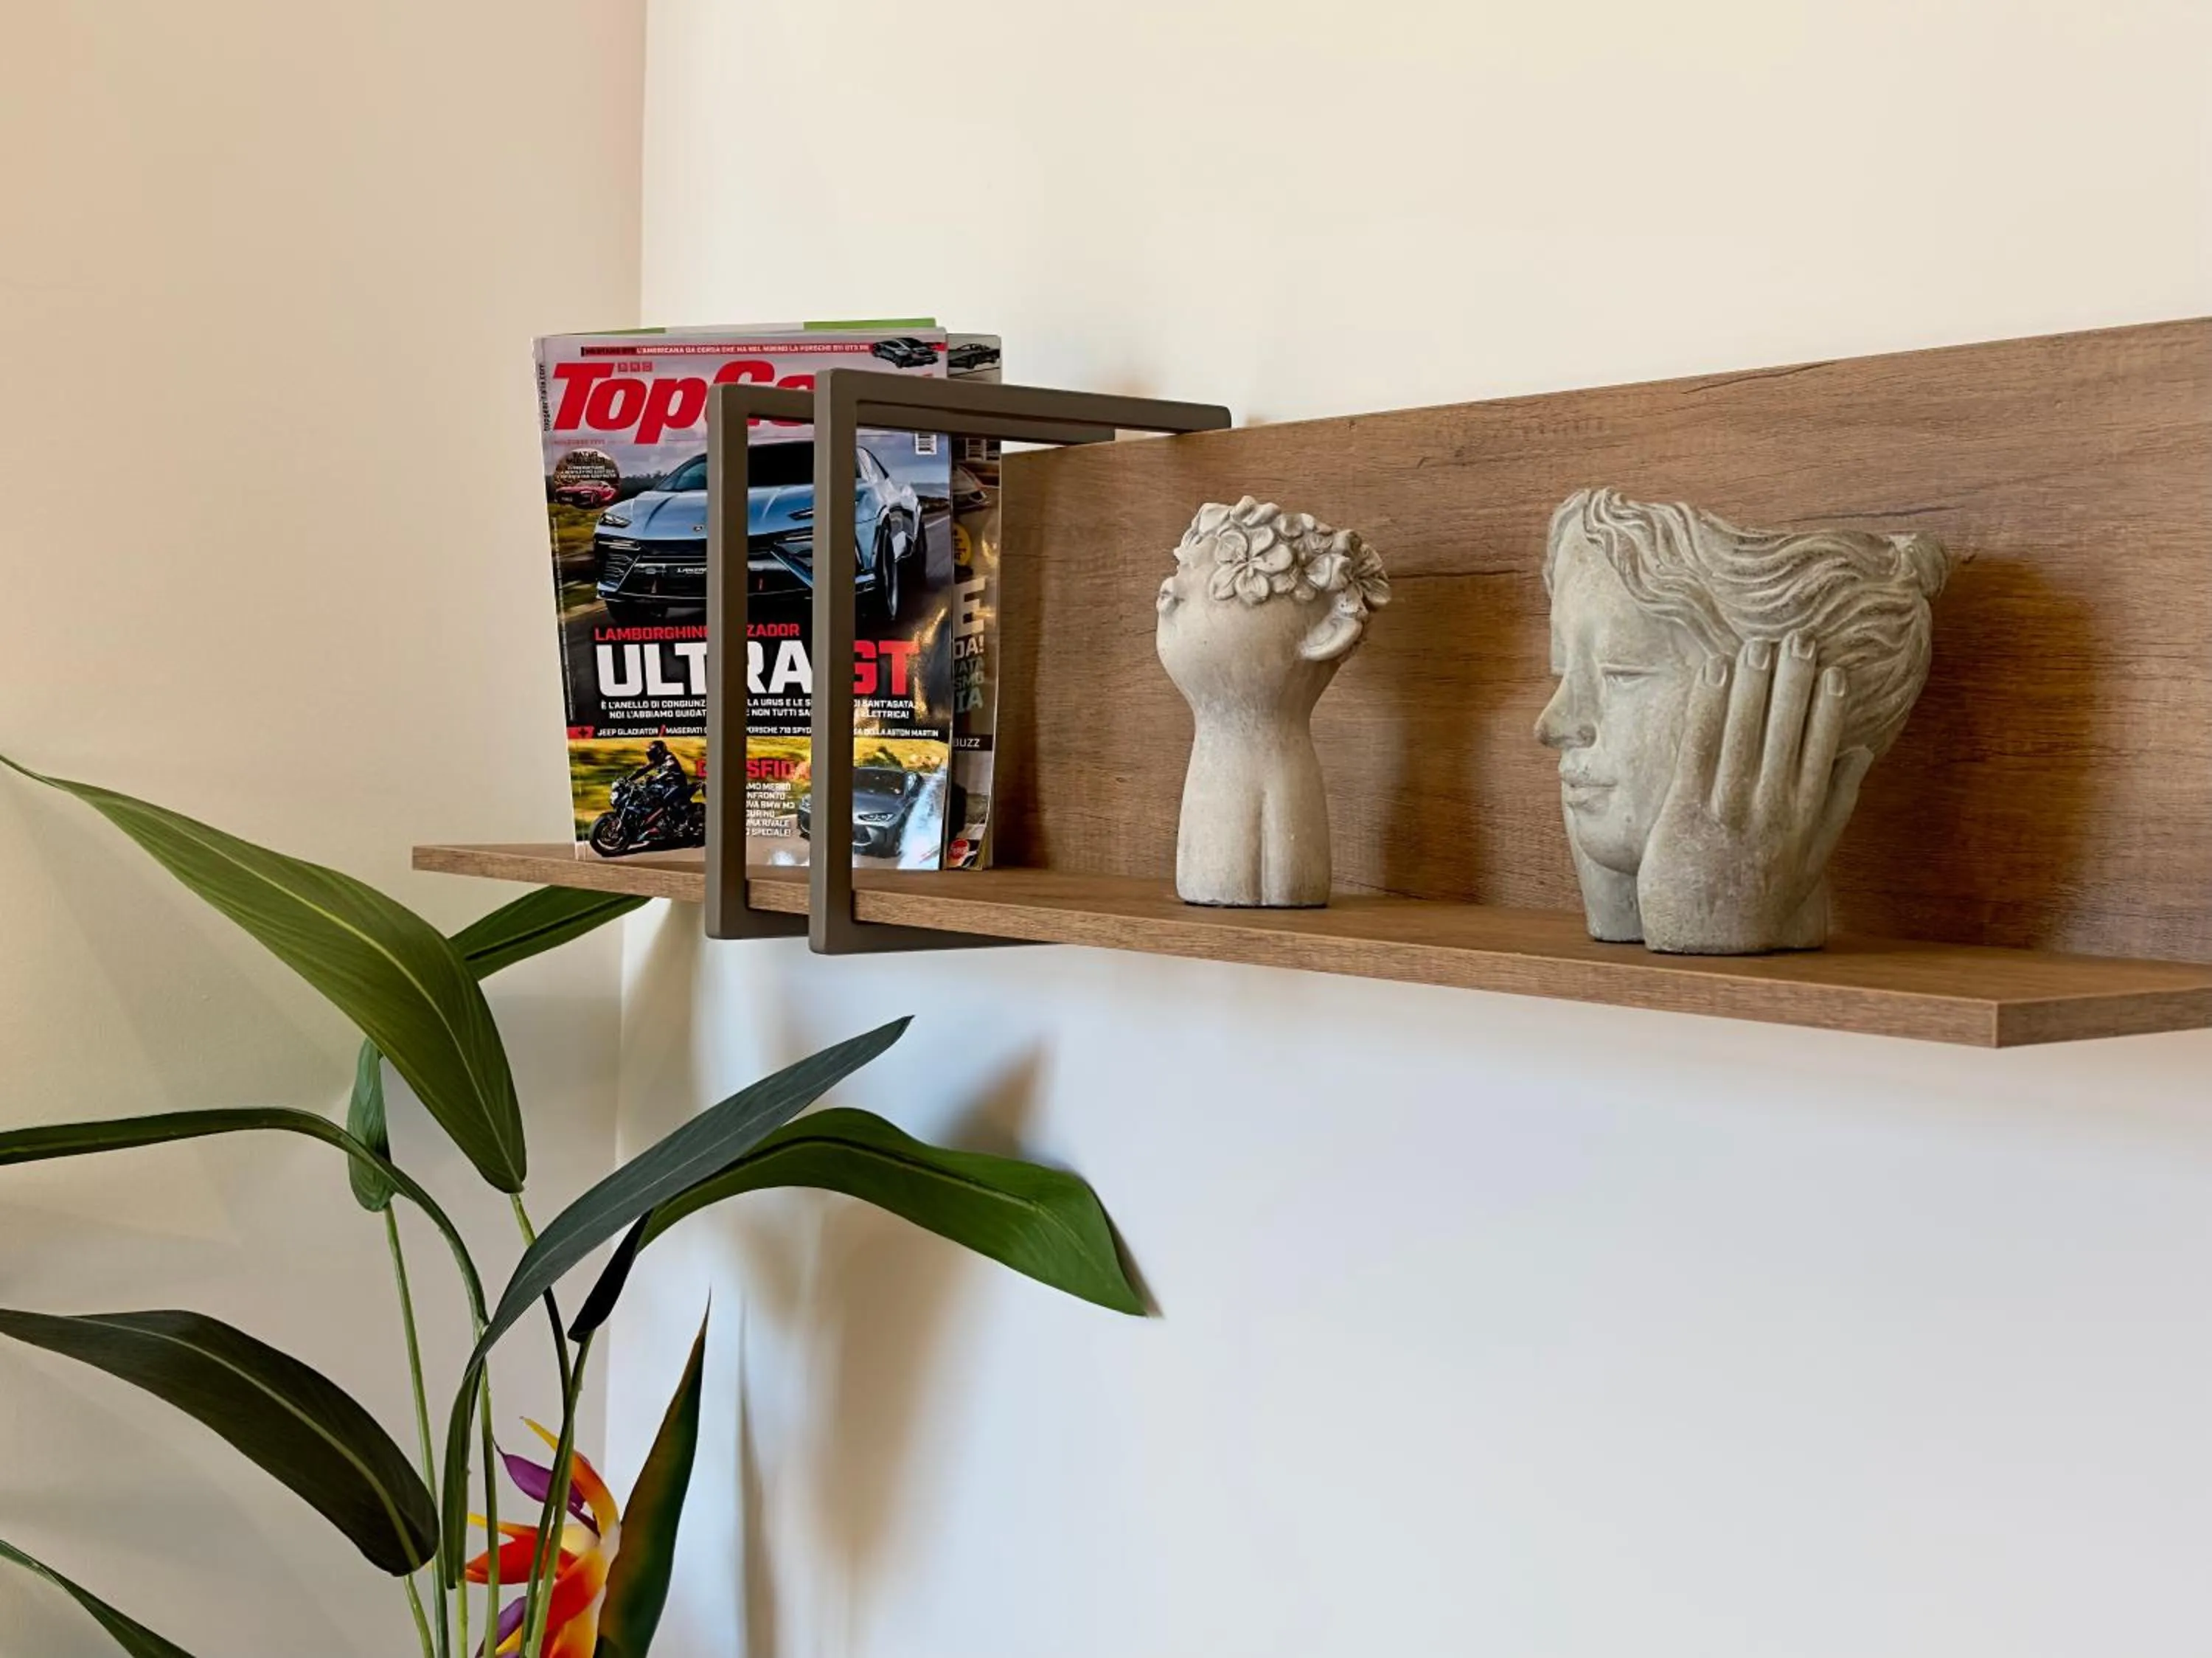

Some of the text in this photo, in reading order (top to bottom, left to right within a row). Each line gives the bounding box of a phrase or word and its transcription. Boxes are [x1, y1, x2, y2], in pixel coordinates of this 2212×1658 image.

[746, 623, 801, 637] ZADOR
[608, 700, 650, 710] L'ANELLO
[651, 700, 660, 709] DI
[661, 698, 707, 708] CONGIUNZ
[747, 698, 759, 707] LA
[760, 698, 785, 707] URUS
[785, 698, 792, 707] E
[793, 698, 803, 707] LE
[609, 710, 625, 719] NOI
[627, 710, 673, 718] L'ABBIAMO
[675, 709, 707, 718] GUIDAT
[773, 709, 797, 717] TUTTI
[597, 728, 616, 737] JEEP
[618, 726, 658, 736] GLADIATOR
[666, 726, 703, 735] MASERATI
[747, 726, 778, 734] ORSCHE
[911, 729, 939, 737] MARTIN
[747, 791, 786, 800] NFRONTO
[760, 819, 790, 828] RIVALE
